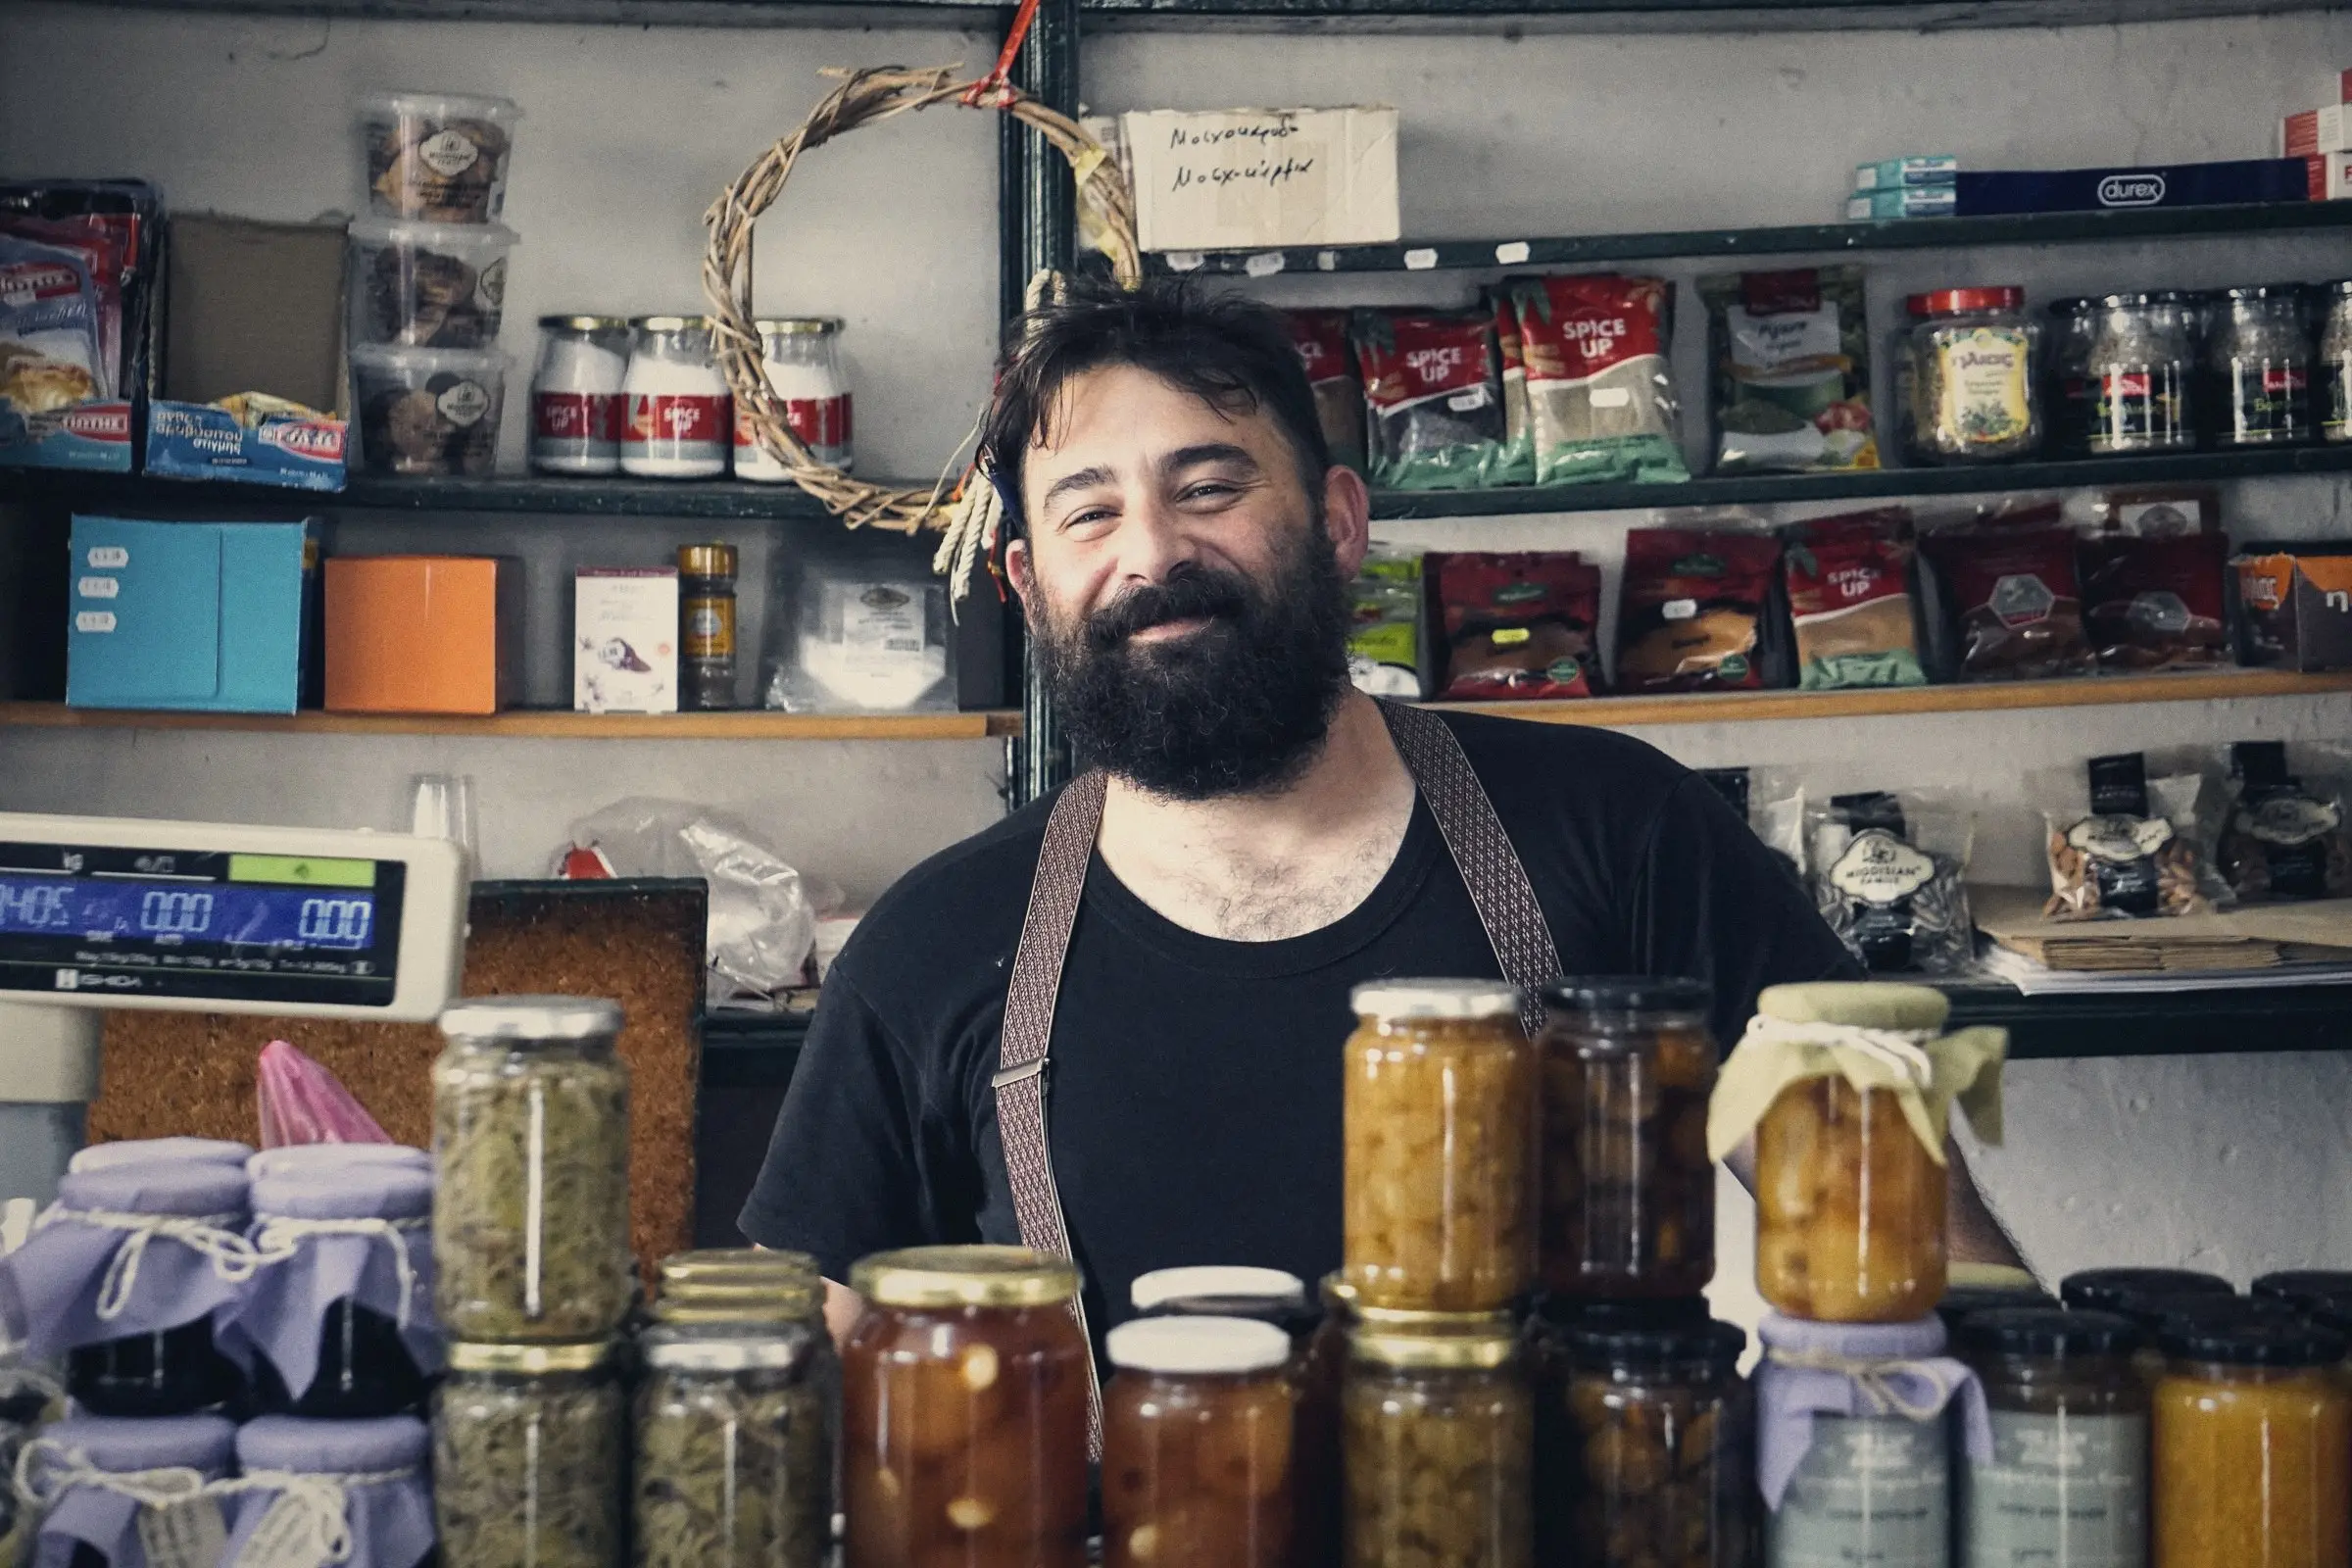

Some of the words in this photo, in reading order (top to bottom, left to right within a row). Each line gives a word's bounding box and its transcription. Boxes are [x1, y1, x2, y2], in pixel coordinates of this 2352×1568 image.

[2105, 178, 2159, 201] durex
[1561, 318, 1627, 340] SPICE
[1404, 346, 1463, 368] SPICE
[1579, 338, 1615, 359] UP
[1419, 364, 1450, 383] UP
[662, 407, 701, 422] SPICE
[1839, 580, 1872, 598] UP
